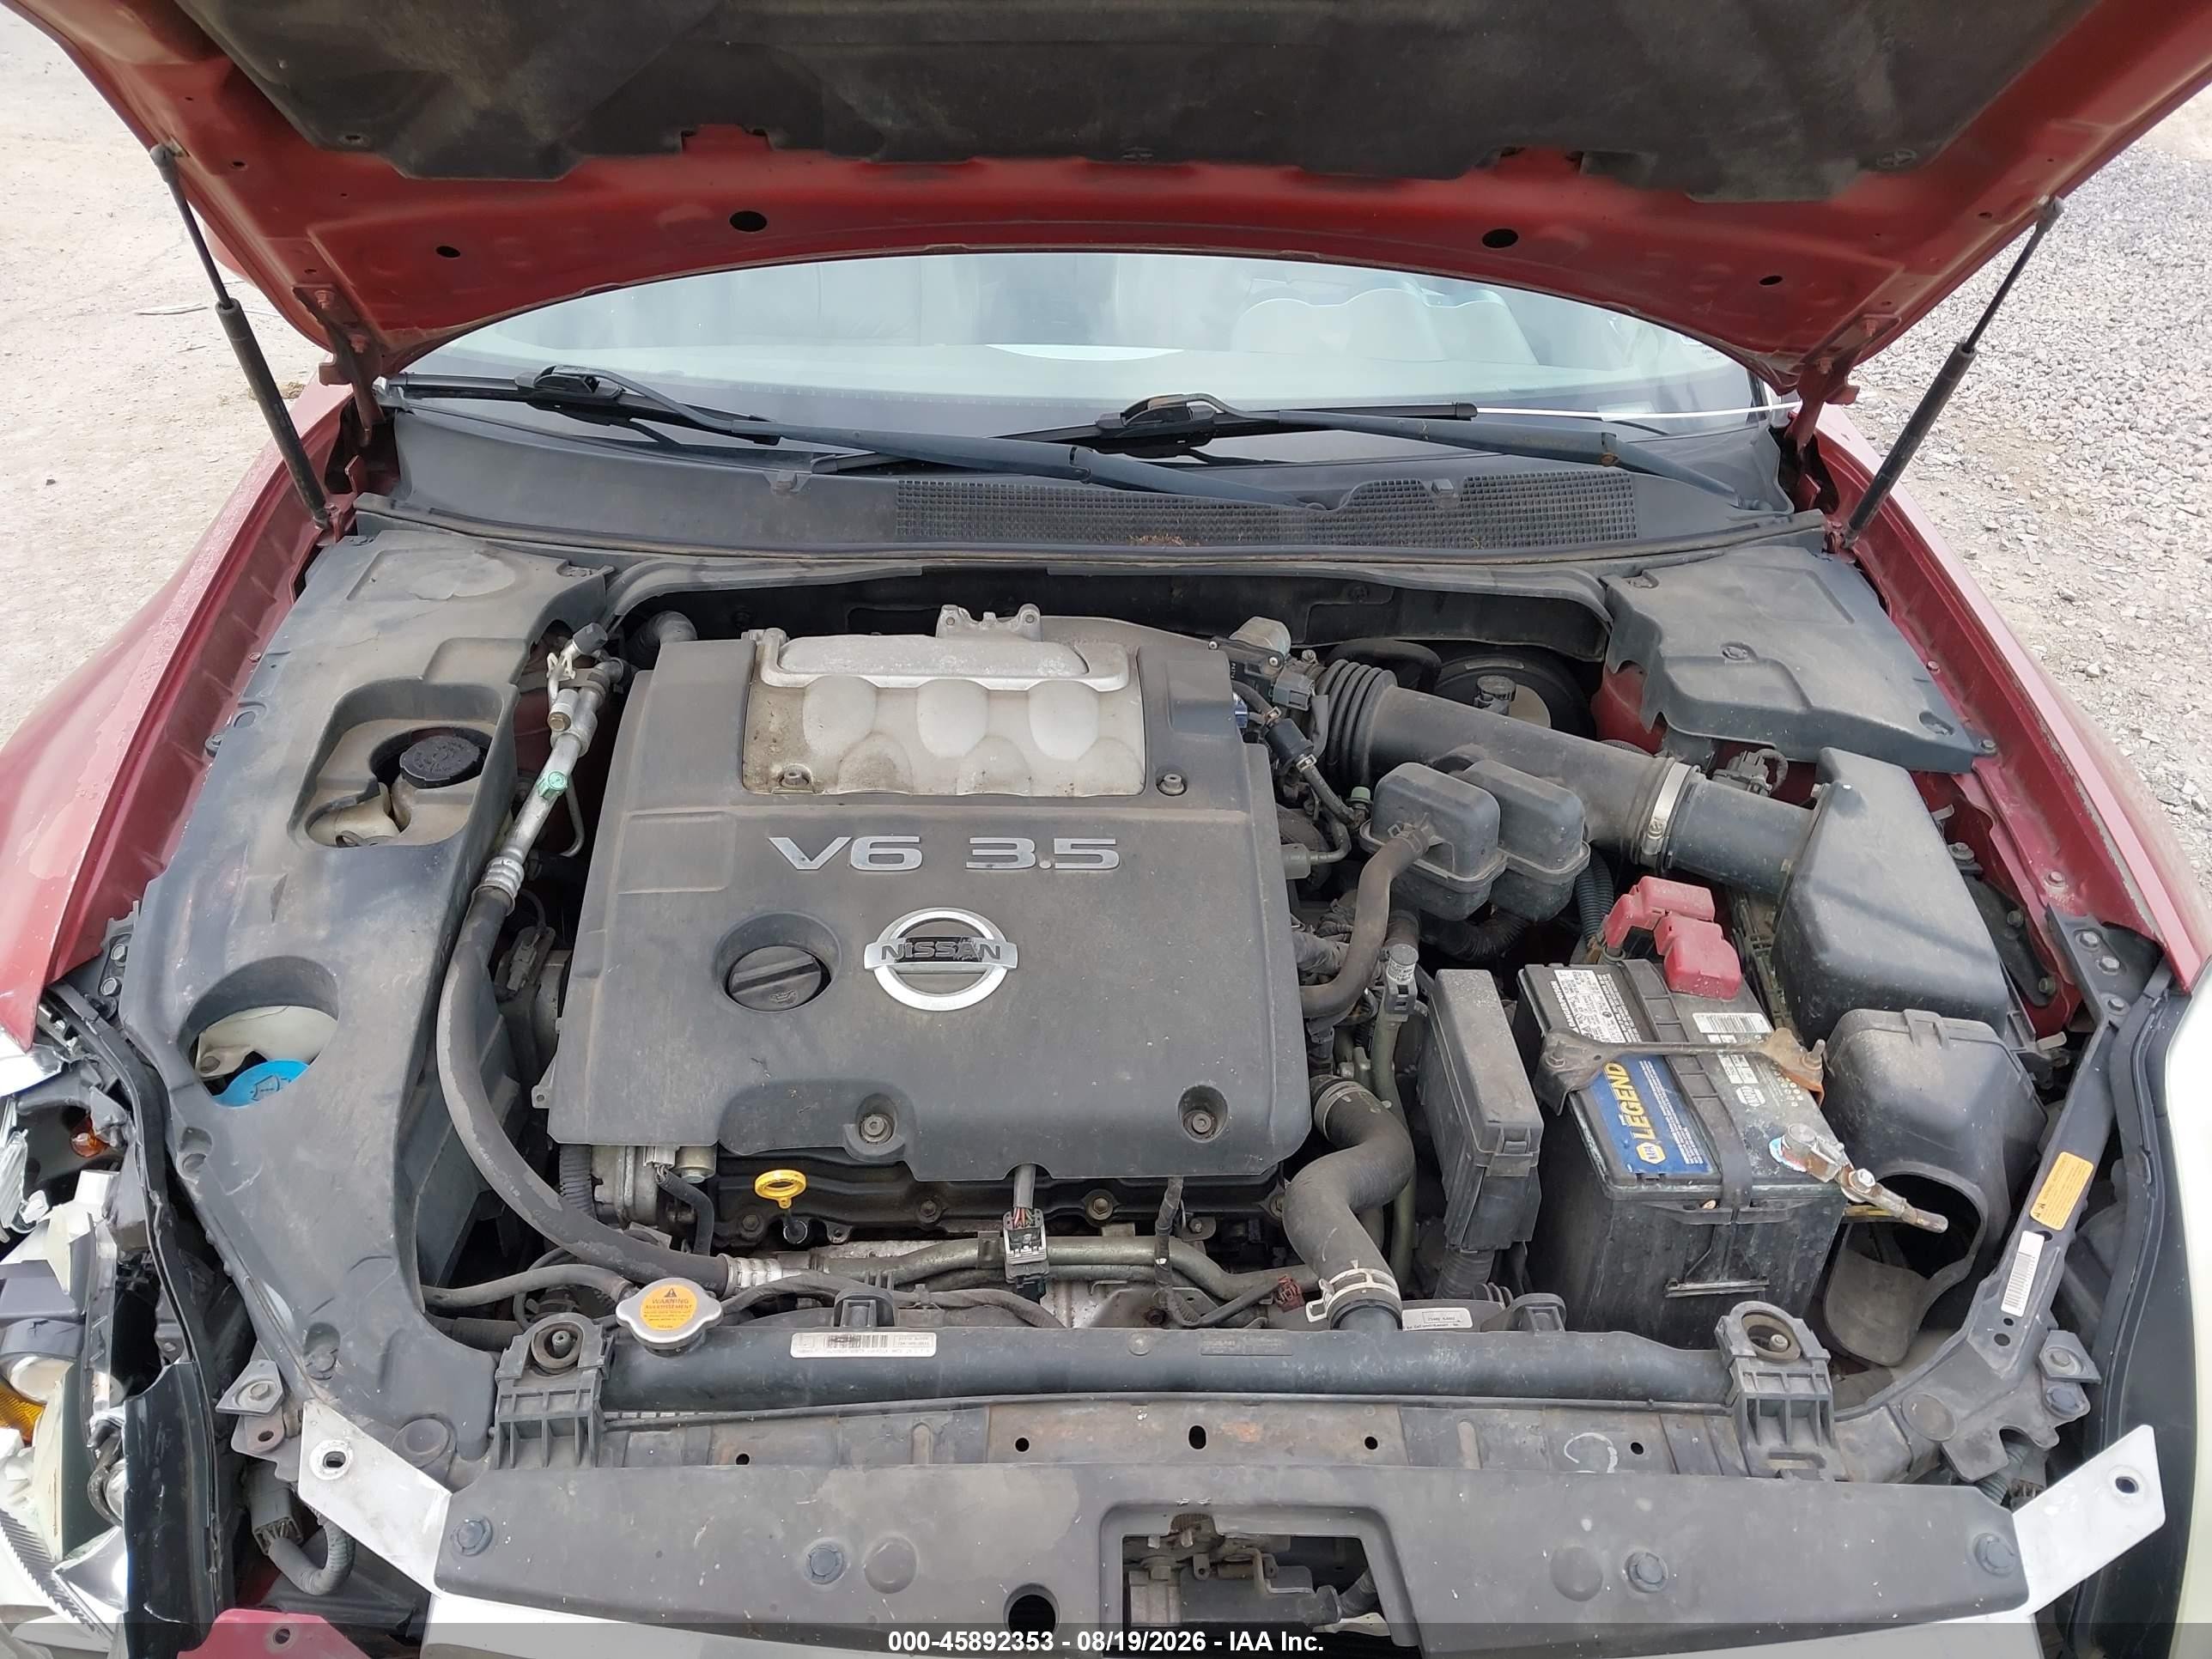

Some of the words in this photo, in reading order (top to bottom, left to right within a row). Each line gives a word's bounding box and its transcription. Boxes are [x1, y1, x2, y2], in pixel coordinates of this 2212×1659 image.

[769, 836, 923, 871] V6
[965, 836, 1120, 871] 3.5
[881, 941, 1001, 962] NISSAN
[1603, 1062, 1656, 1140] LEGEND
